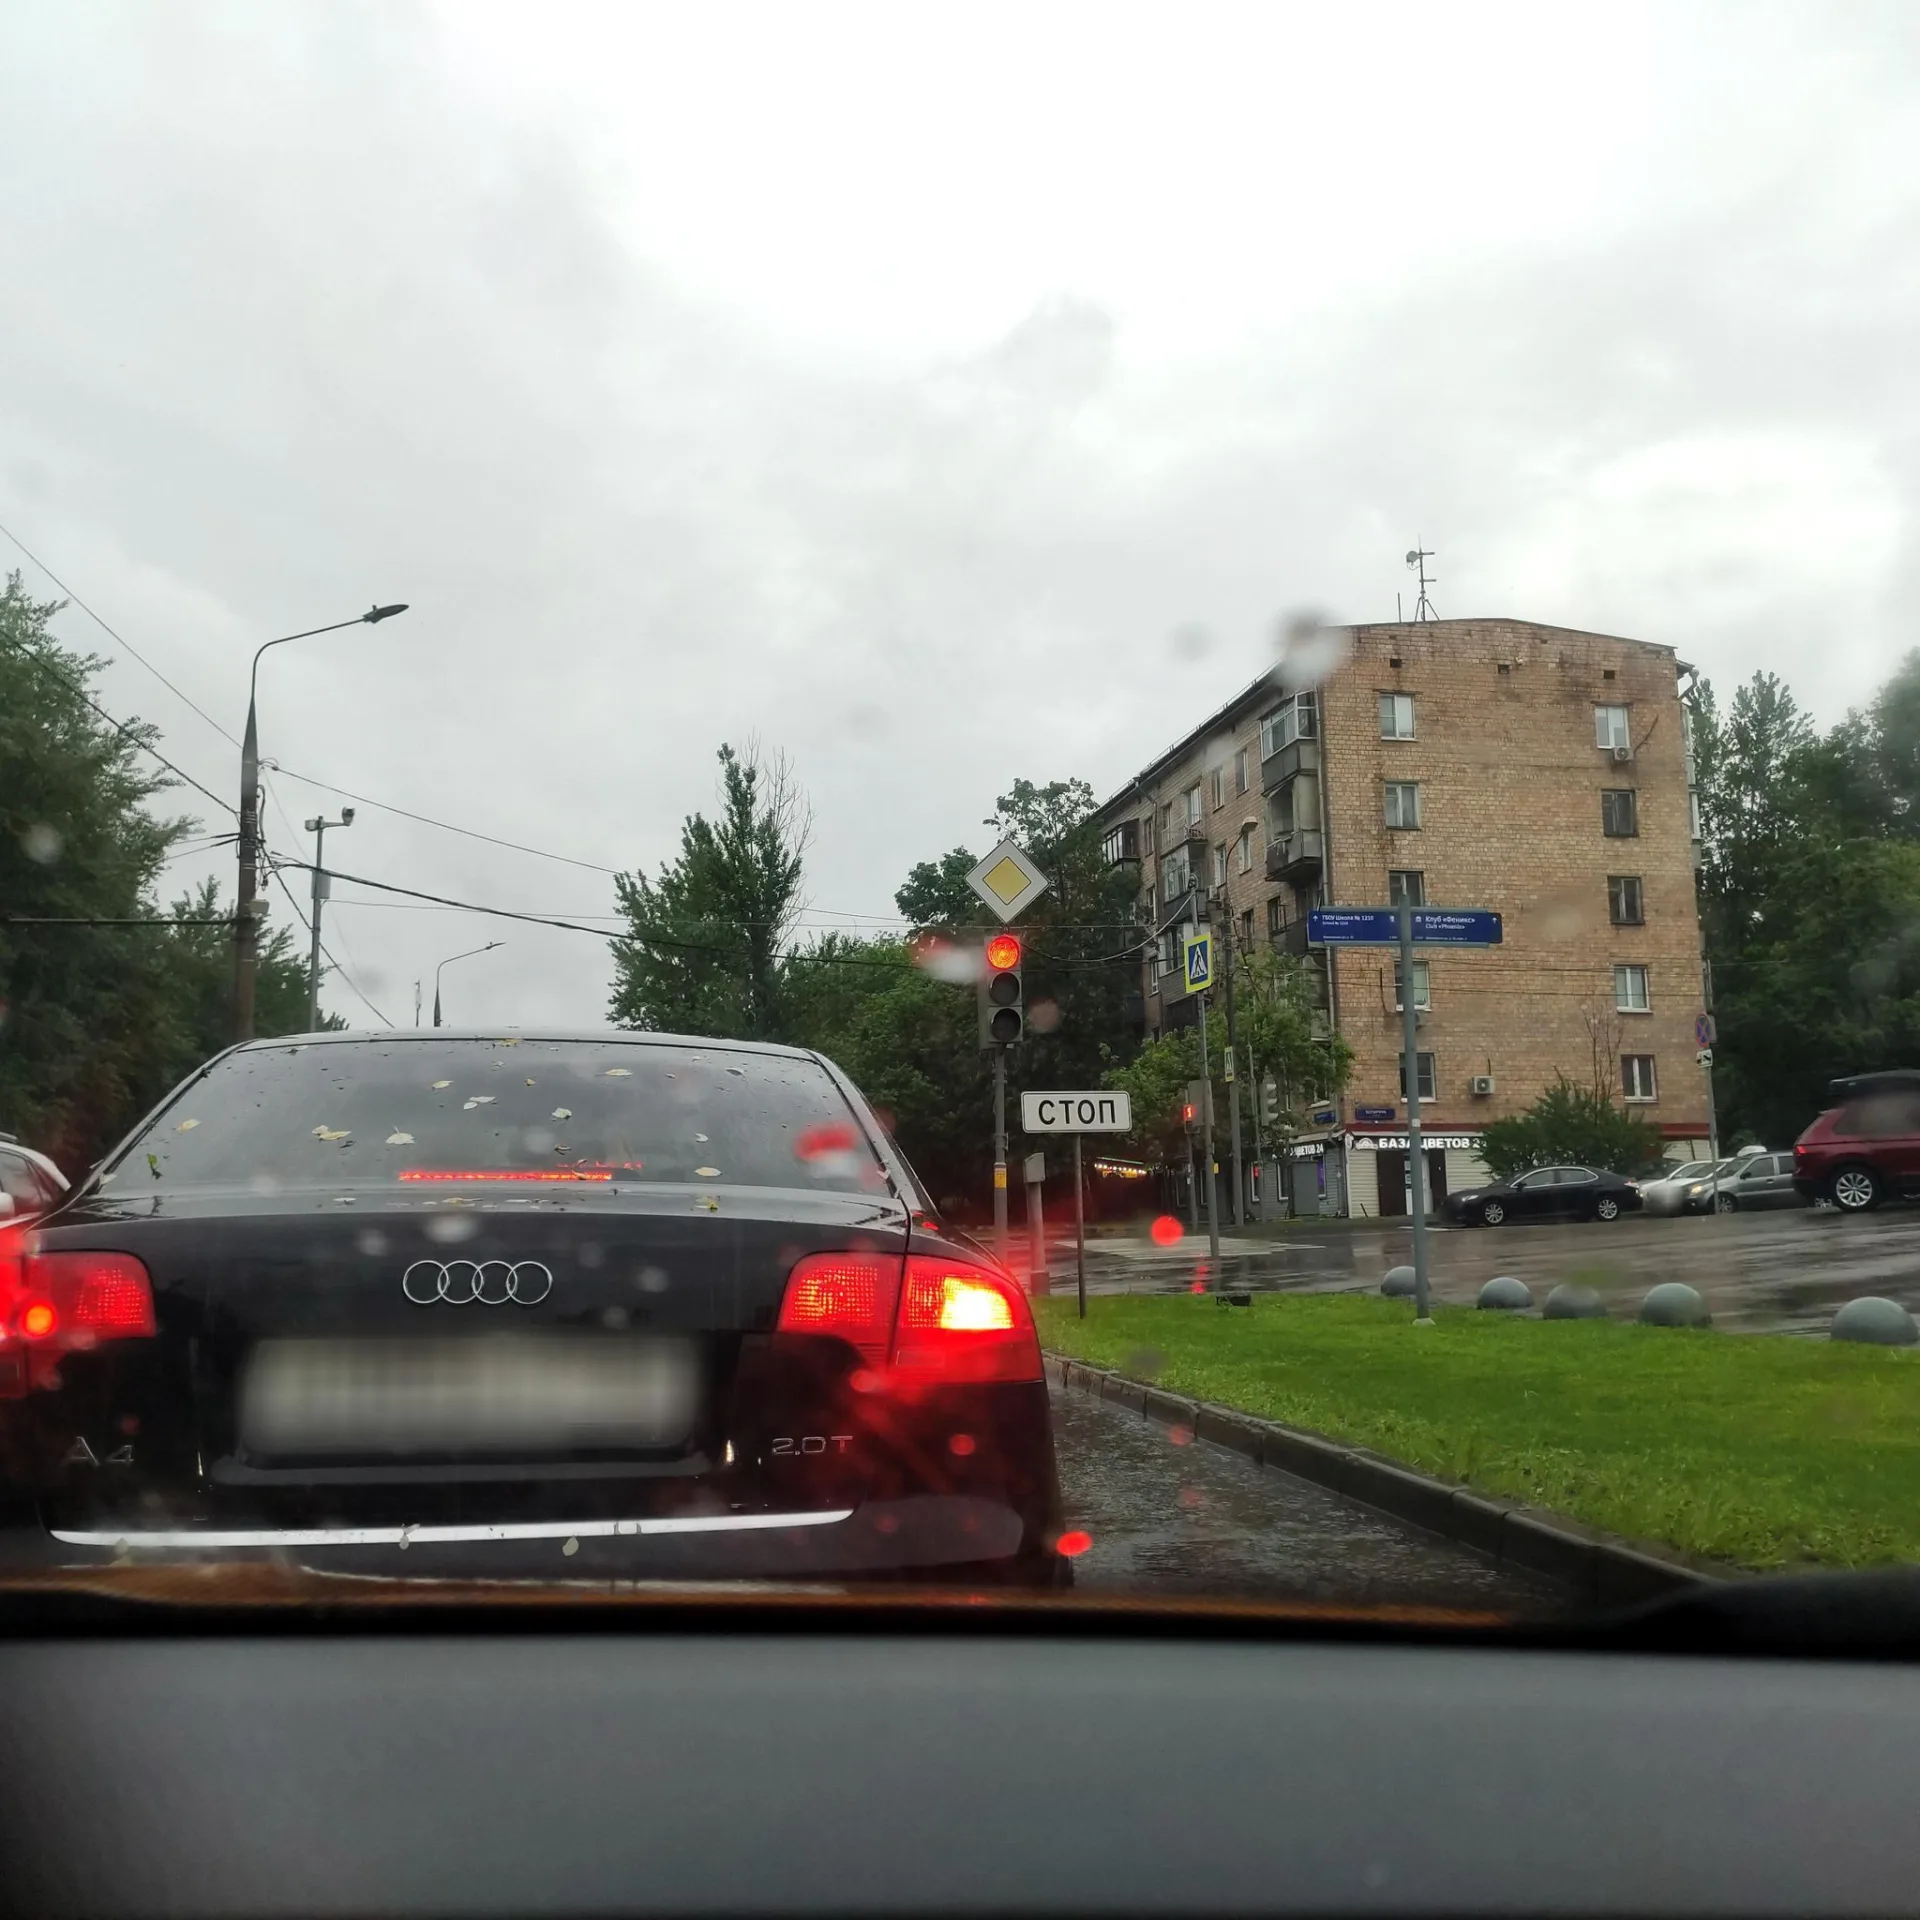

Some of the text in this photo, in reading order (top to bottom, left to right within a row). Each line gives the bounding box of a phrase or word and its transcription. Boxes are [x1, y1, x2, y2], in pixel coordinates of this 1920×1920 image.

[1425, 915, 1442, 924] Клуб
[1038, 1099, 1116, 1125] СТОП
[1316, 1143, 1324, 1154] 24
[1420, 1137, 1470, 1150] ЦВЕТОВ
[62, 1435, 135, 1468] A4
[771, 1435, 854, 1455] 2.0T
